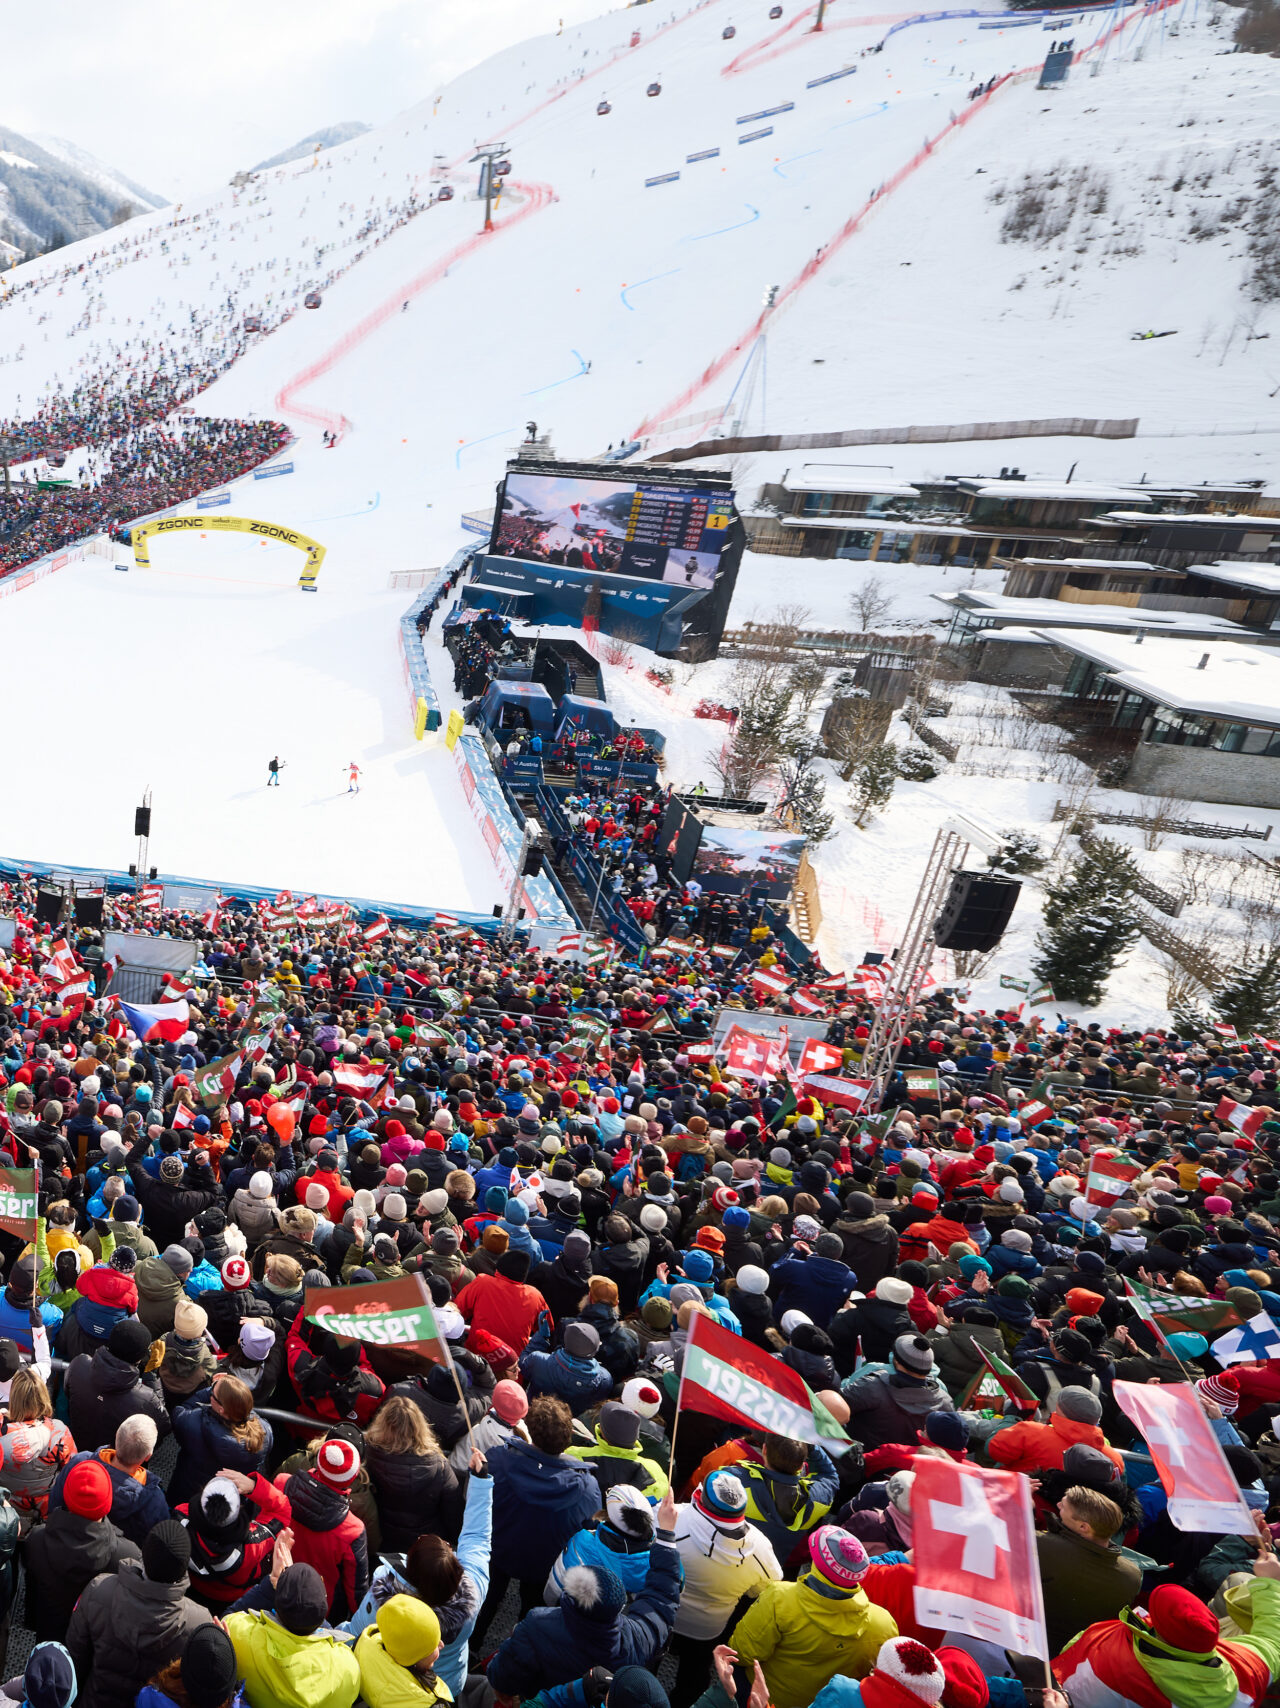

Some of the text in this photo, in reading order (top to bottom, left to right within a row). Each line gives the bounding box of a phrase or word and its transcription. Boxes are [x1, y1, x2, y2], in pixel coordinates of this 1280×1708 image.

[157, 518, 203, 530] ZGONC
[714, 516, 720, 527] 1
[250, 523, 298, 544] ZGONC
[315, 1305, 420, 1344] Gösser
[487, 1345, 510, 1362] SUI
